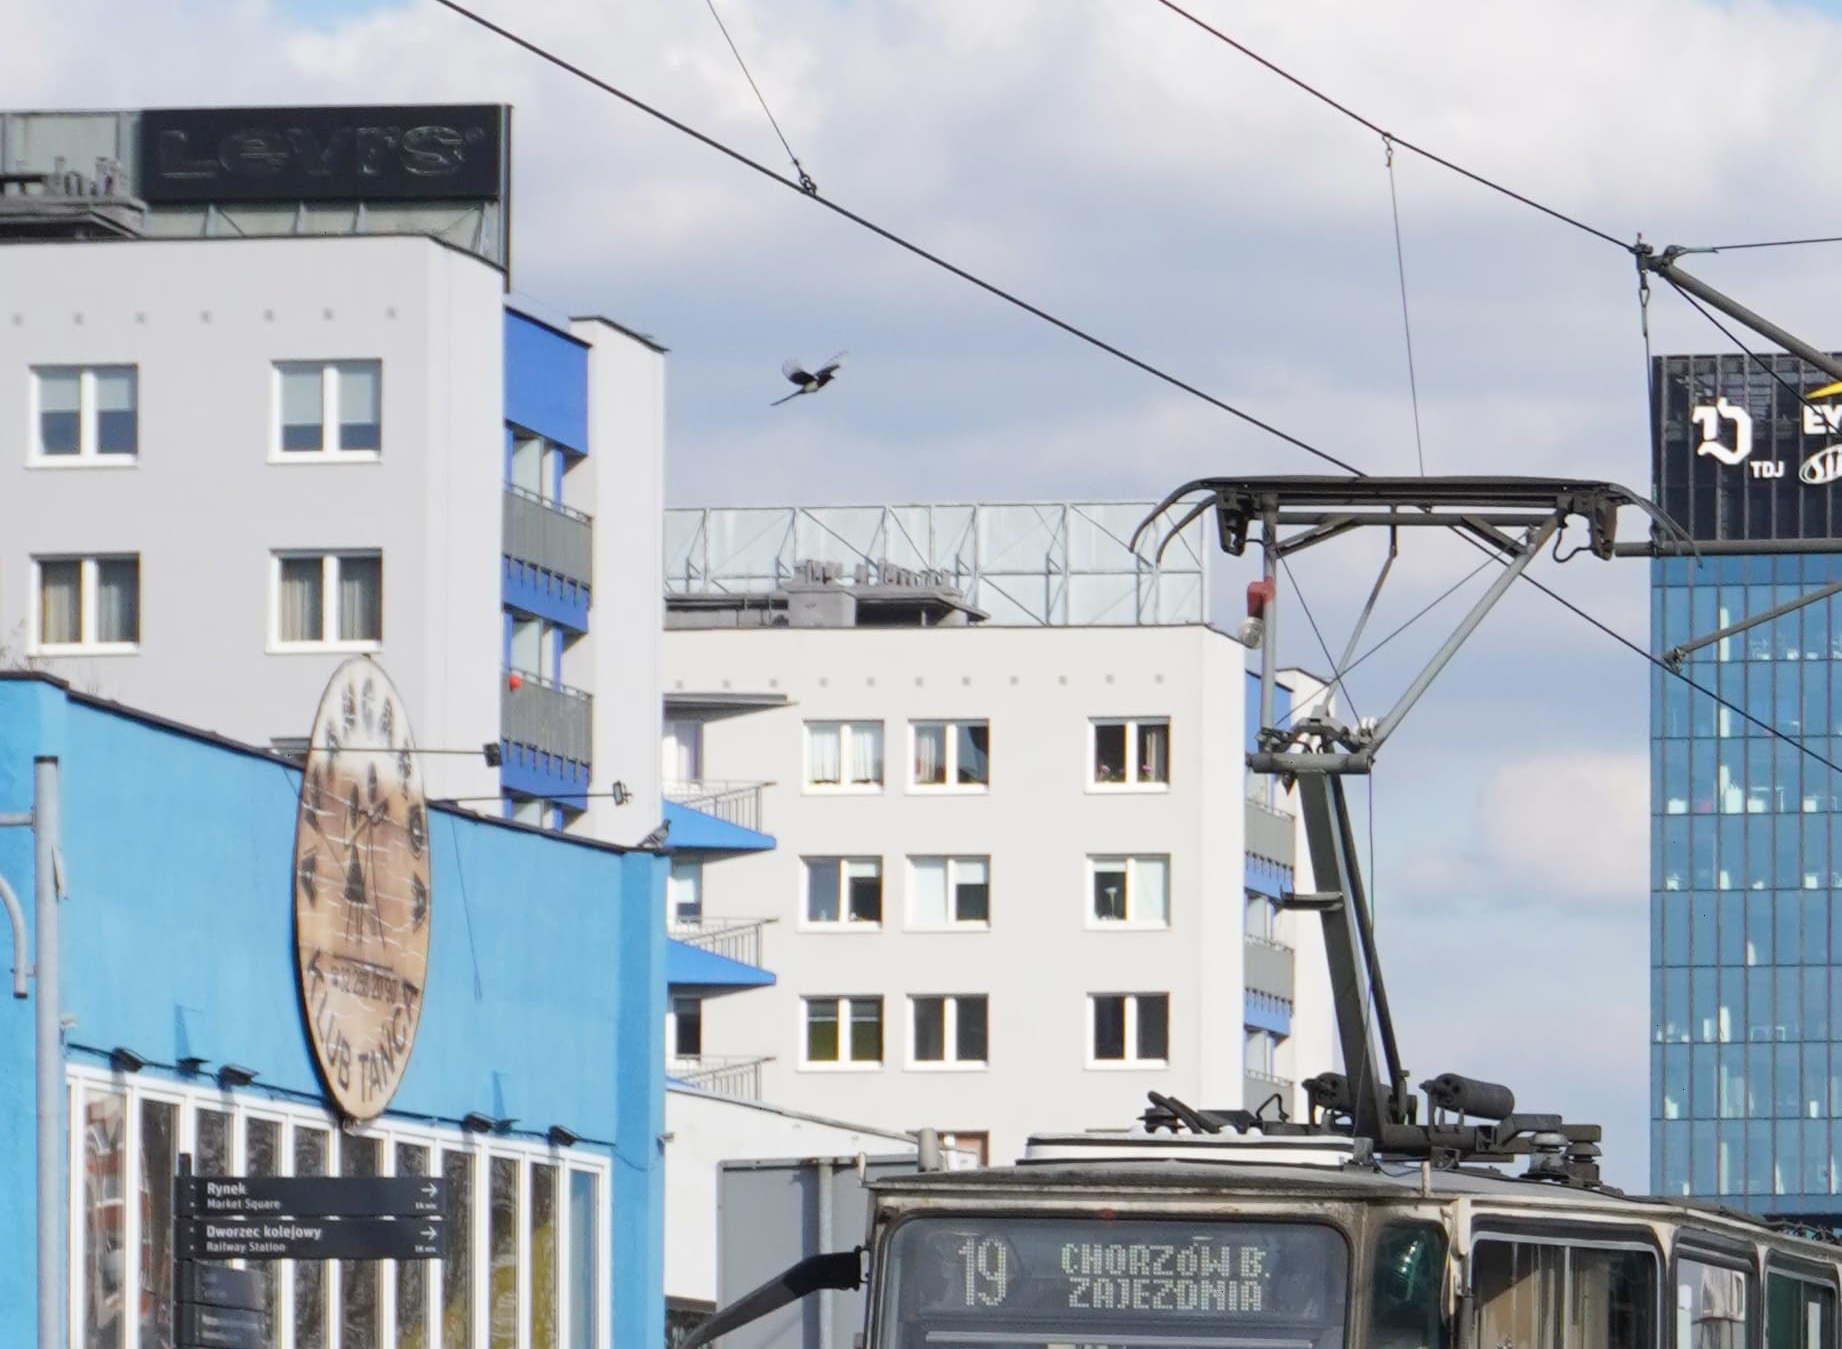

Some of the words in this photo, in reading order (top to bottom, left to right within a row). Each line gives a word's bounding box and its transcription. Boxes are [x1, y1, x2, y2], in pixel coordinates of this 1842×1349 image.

[1750, 460, 1785, 479] TDJ
[207, 1182, 247, 1198] Rynek
[207, 1198, 242, 1209] Market
[245, 1199, 281, 1211] Square
[206, 1225, 261, 1238] Dworzec
[263, 1225, 322, 1241] kolejowy
[206, 1242, 247, 1253] Railway
[249, 1242, 286, 1253] Station
[1061, 1241, 1230, 1278] CHORZÓW
[1239, 1244, 1271, 1279] B.
[958, 1237, 1007, 1307] 19
[1068, 1276, 1262, 1312] ZAJEZDNIA
